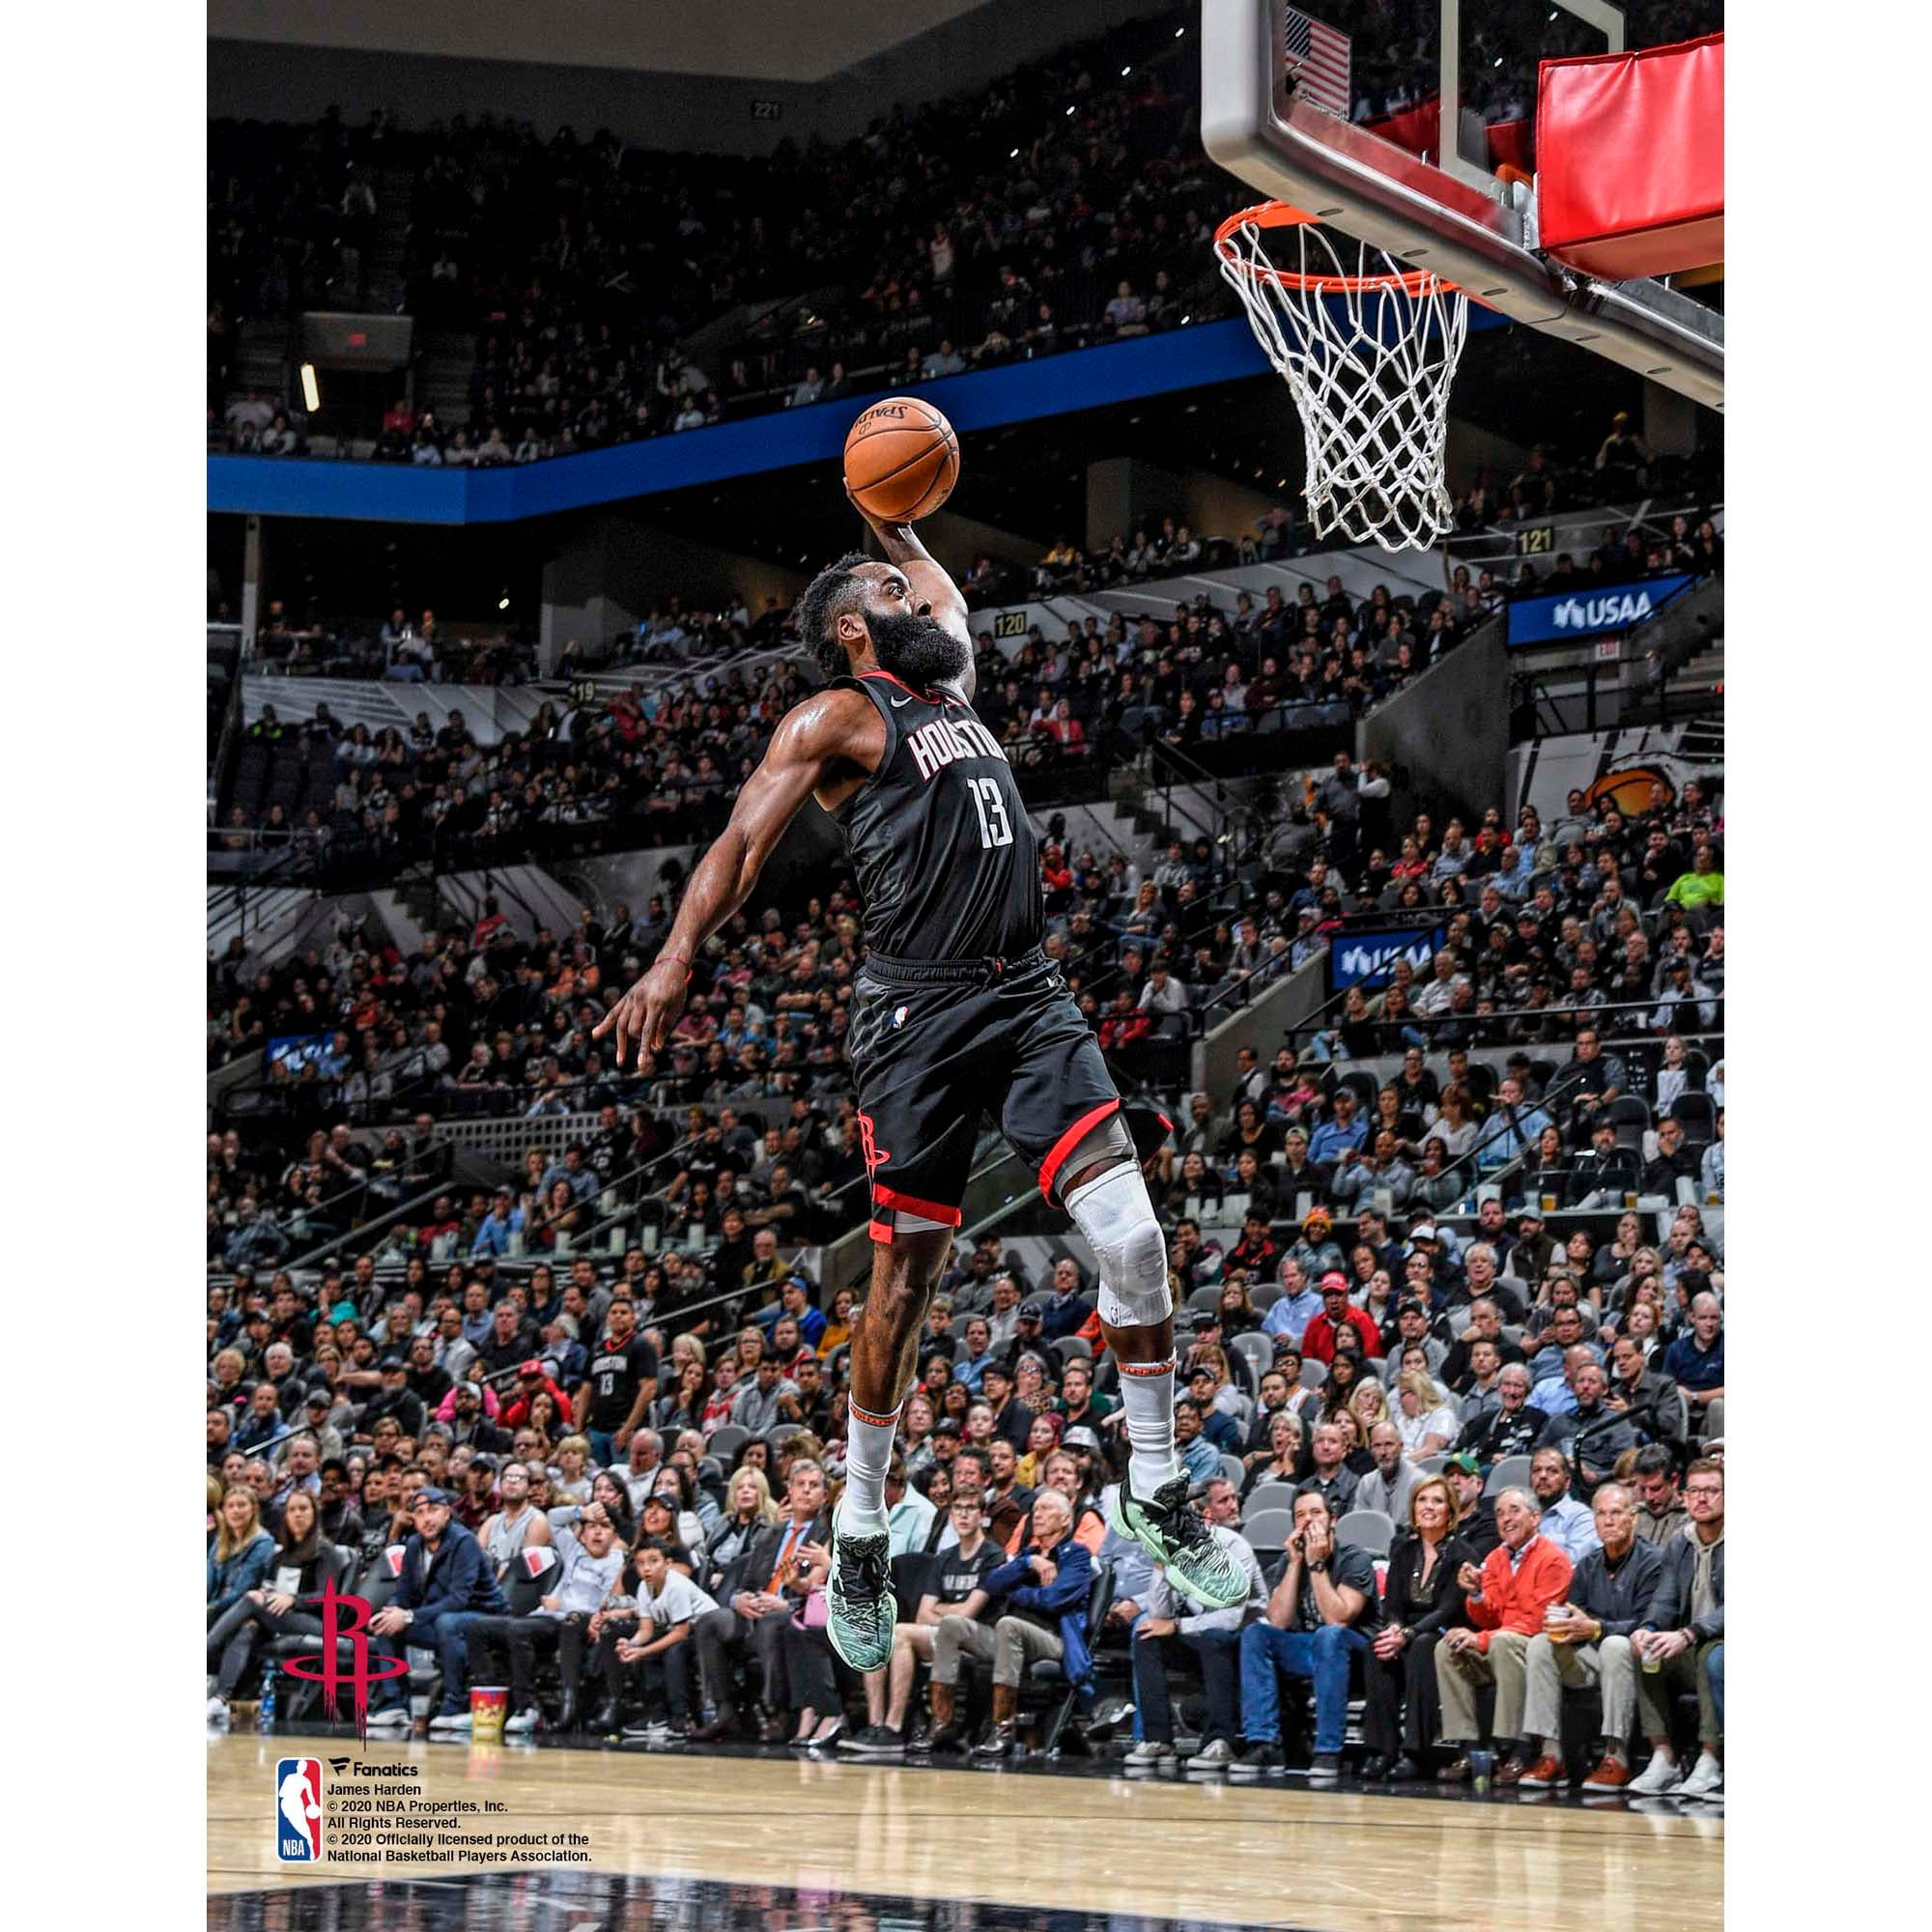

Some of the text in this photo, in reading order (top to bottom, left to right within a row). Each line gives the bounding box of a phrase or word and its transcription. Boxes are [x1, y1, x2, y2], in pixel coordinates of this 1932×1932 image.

[1519, 528, 1551, 553] 121
[1587, 590, 1654, 627] USAA
[996, 613, 1024, 636] 120
[967, 778, 1013, 848] 13
[601, 1373, 614, 1396] 13
